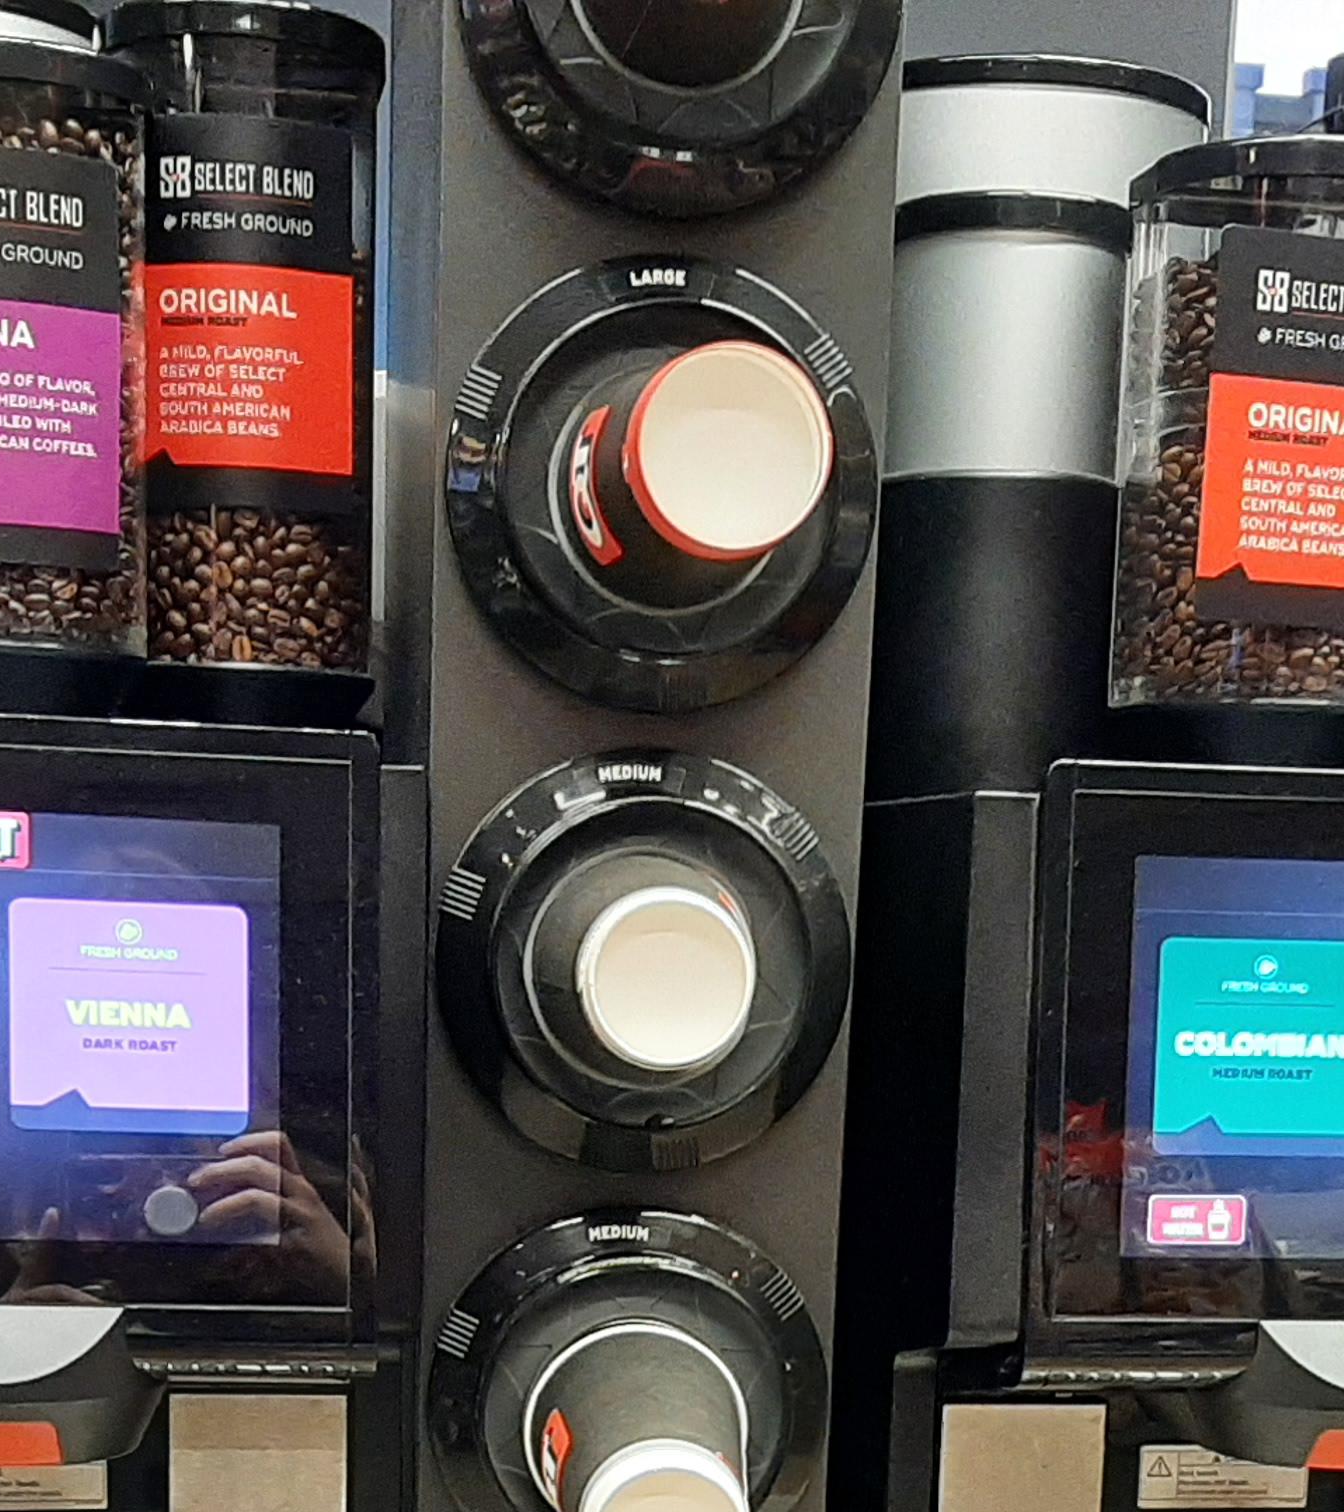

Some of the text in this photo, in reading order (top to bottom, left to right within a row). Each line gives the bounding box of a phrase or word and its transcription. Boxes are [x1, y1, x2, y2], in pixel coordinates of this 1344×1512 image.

[195, 163, 256, 194] SELECT
[262, 166, 314, 199] BLEND
[26, 193, 84, 228] BLEND
[181, 211, 313, 237] FRESH GROUND
[1, 244, 84, 269] GROUND
[630, 268, 686, 288] LARGE
[160, 288, 297, 319] ORIGINAL
[1291, 281, 1344, 313] SELECT
[1275, 328, 1326, 347] FRESH
[160, 347, 169, 360] A
[214, 346, 304, 365] FLAVORFUL
[14, 374, 34, 387] OF
[205, 364, 224, 378] OF
[229, 365, 286, 381] SELECT
[160, 383, 264, 398] CENTRAL AND
[160, 402, 291, 421] SOUTH AMERICAN
[35, 417, 71, 433] WITH
[1244, 459, 1253, 472] A
[1243, 478, 1284, 495] BREW
[1287, 482, 1304, 496] OF
[1241, 497, 1336, 517] CENTRAL AND
[1240, 517, 1287, 532] SOUTH
[1239, 534, 1299, 552] ARABICA
[598, 765, 662, 783] MEDIUM
[80, 945, 178, 961] FRESH GROUND
[1260, 981, 1309, 995] GROUND
[65, 999, 191, 1029] VIENNA
[82, 1038, 177, 1053] DARK ROAST
[1212, 1067, 1313, 1081] MEDIUM ROAST
[588, 1225, 650, 1242] MEDIUM
